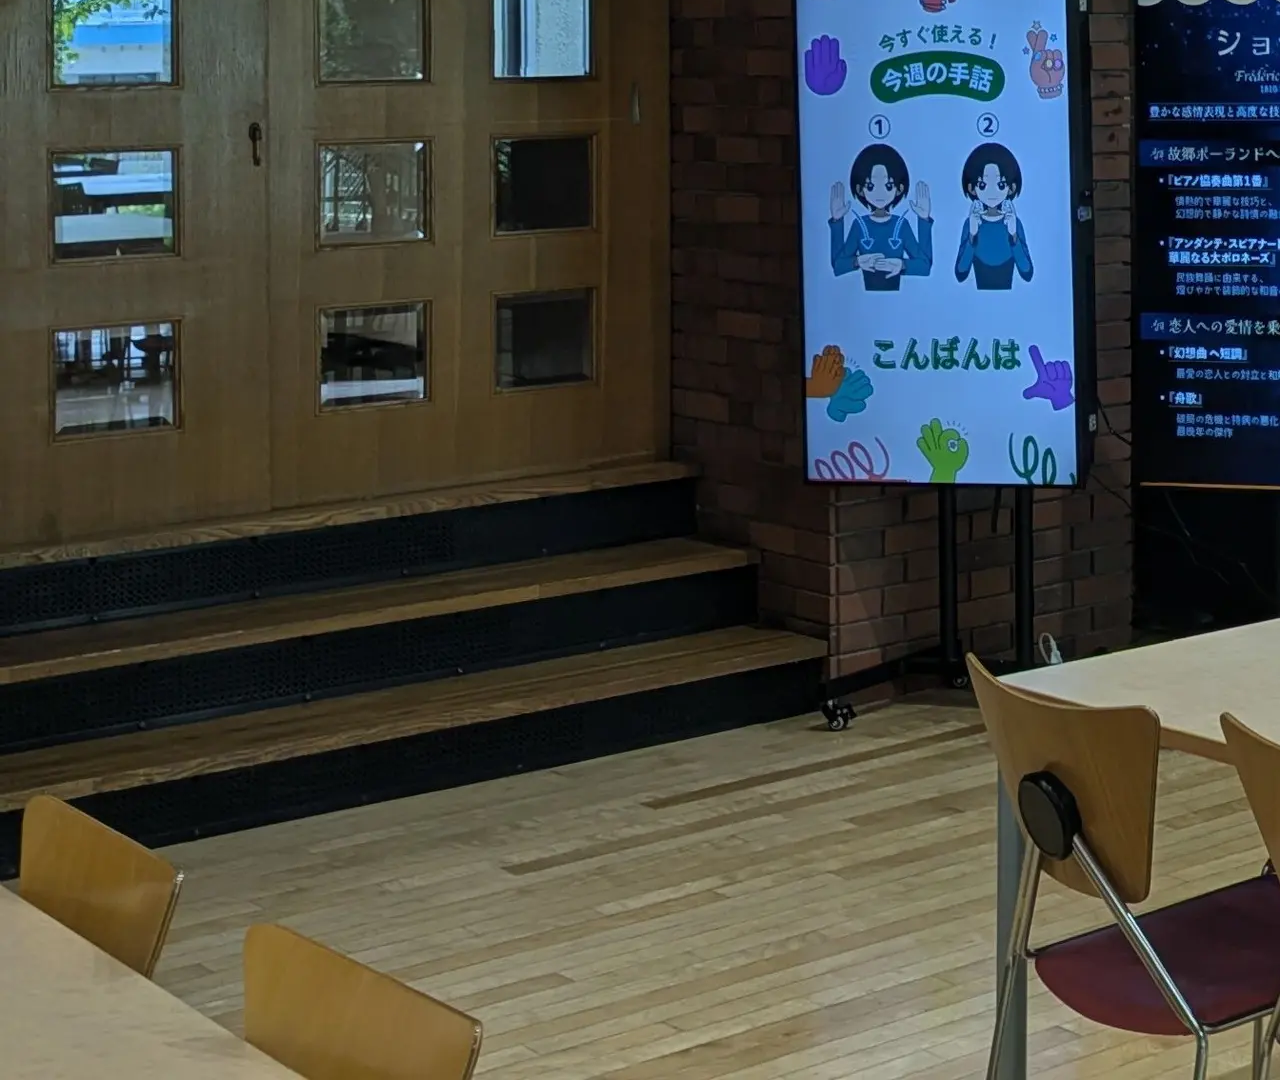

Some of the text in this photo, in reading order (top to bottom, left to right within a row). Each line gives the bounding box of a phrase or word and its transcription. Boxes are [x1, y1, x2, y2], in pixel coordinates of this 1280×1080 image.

[878, 23, 998, 54] 今すぐ使える!
[881, 61, 994, 94] 今週の手話
[872, 337, 1022, 372] こんばんは
